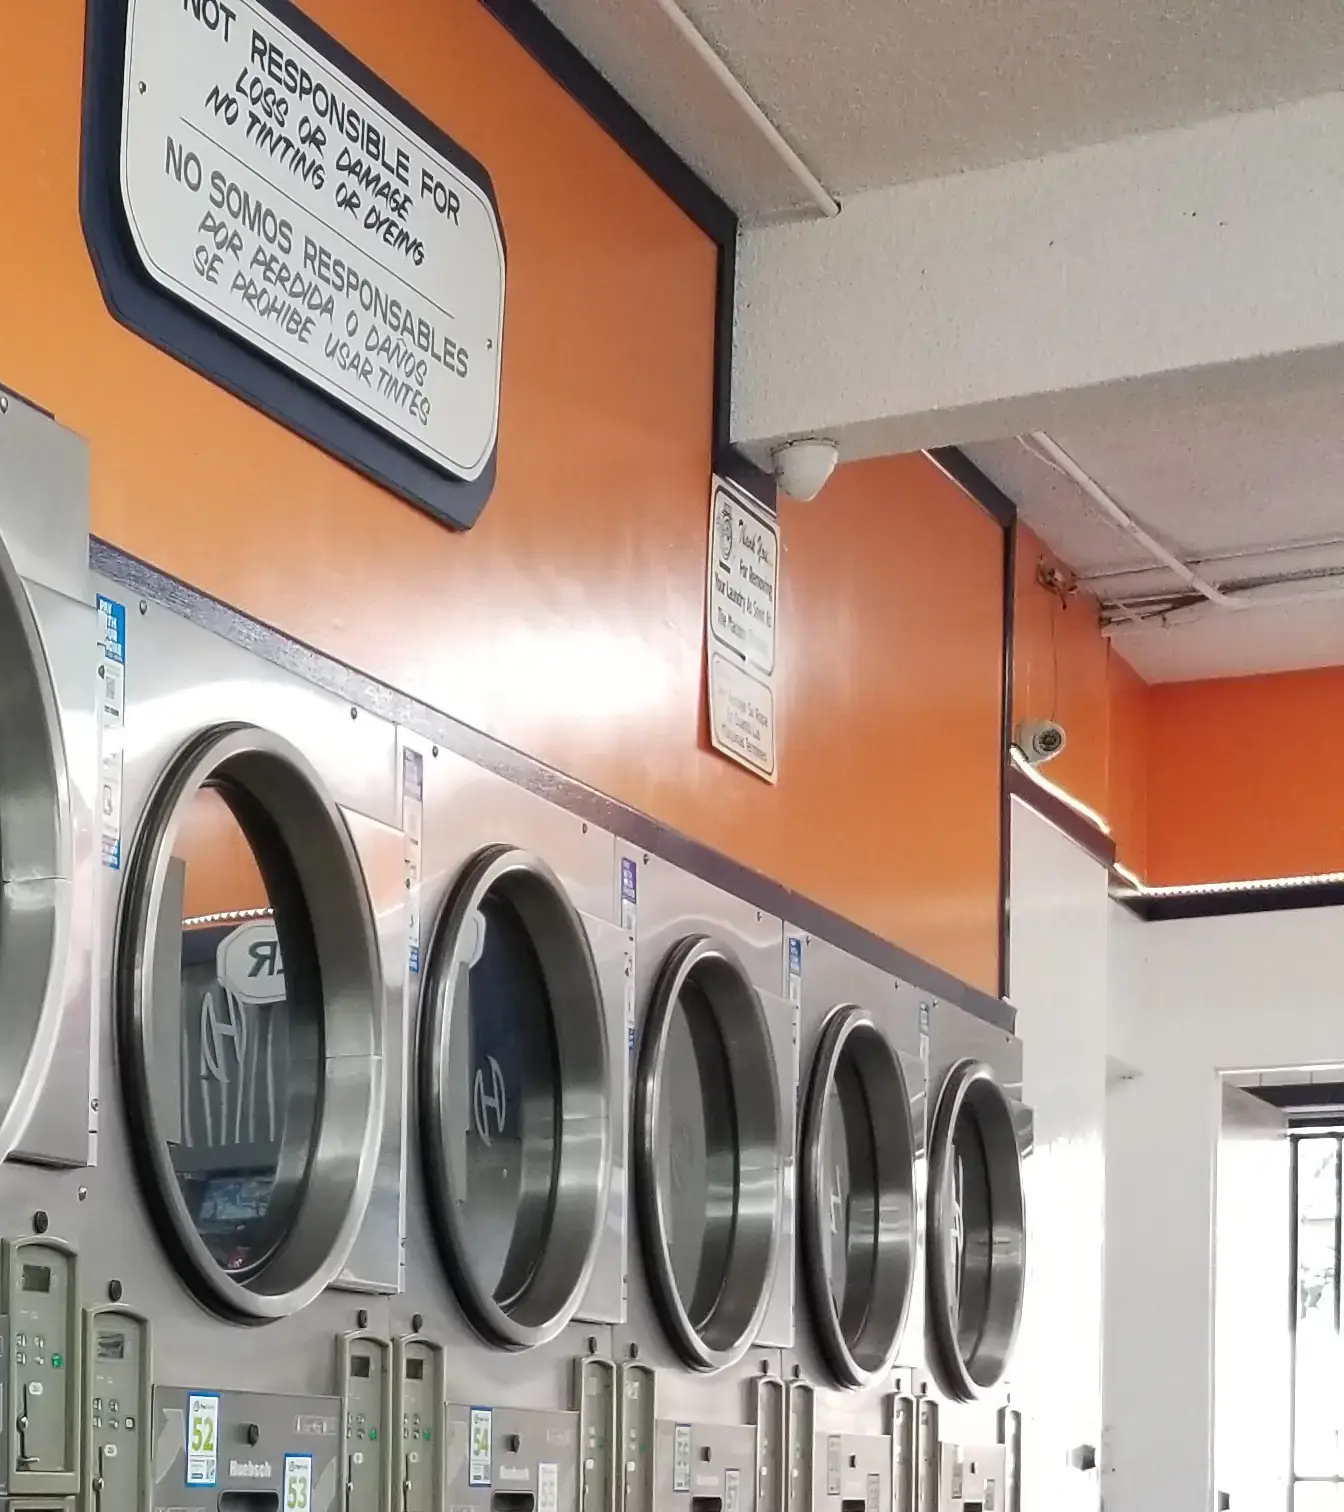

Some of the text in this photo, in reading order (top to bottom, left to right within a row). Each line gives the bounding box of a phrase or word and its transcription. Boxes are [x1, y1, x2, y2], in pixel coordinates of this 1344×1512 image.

[183, 0, 460, 226] NOT RESPONSIBLE FOR
[205, 85, 425, 267] NO TINTING OR DYEING
[234, 67, 414, 221] LOSS OR DAMAGE
[165, 136, 469, 379] NO SOMOS RESPONSABLES
[193, 245, 431, 427] SE PROHIBE USAR TINTES
[198, 210, 428, 388] POR PERDIDA O DAÑOS
[192, 1416, 214, 1451] 52
[287, 1476, 308, 1509] 53
